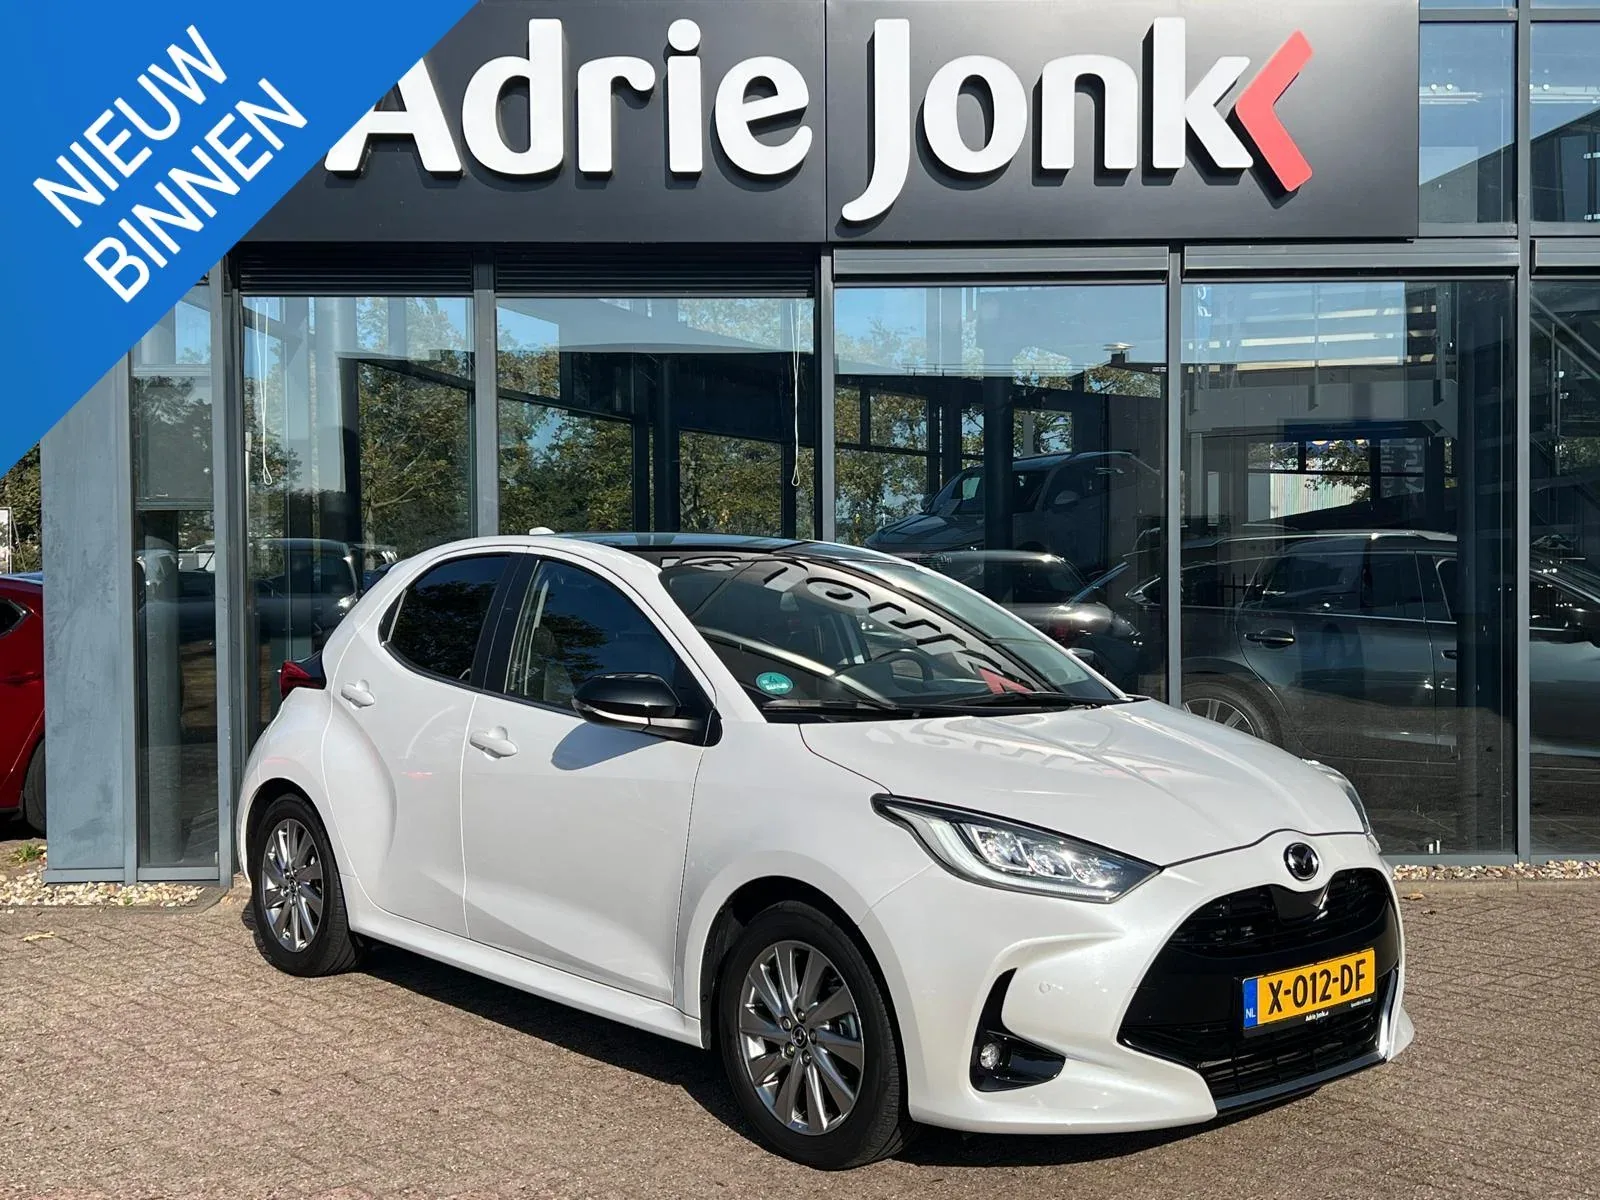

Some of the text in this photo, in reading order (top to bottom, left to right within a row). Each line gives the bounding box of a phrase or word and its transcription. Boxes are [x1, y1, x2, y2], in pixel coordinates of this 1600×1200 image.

[325, 17, 1253, 221] Adrie Jonk
[1245, 1008, 1256, 1019] NL
[1268, 958, 1366, 1015] X-012-DF
